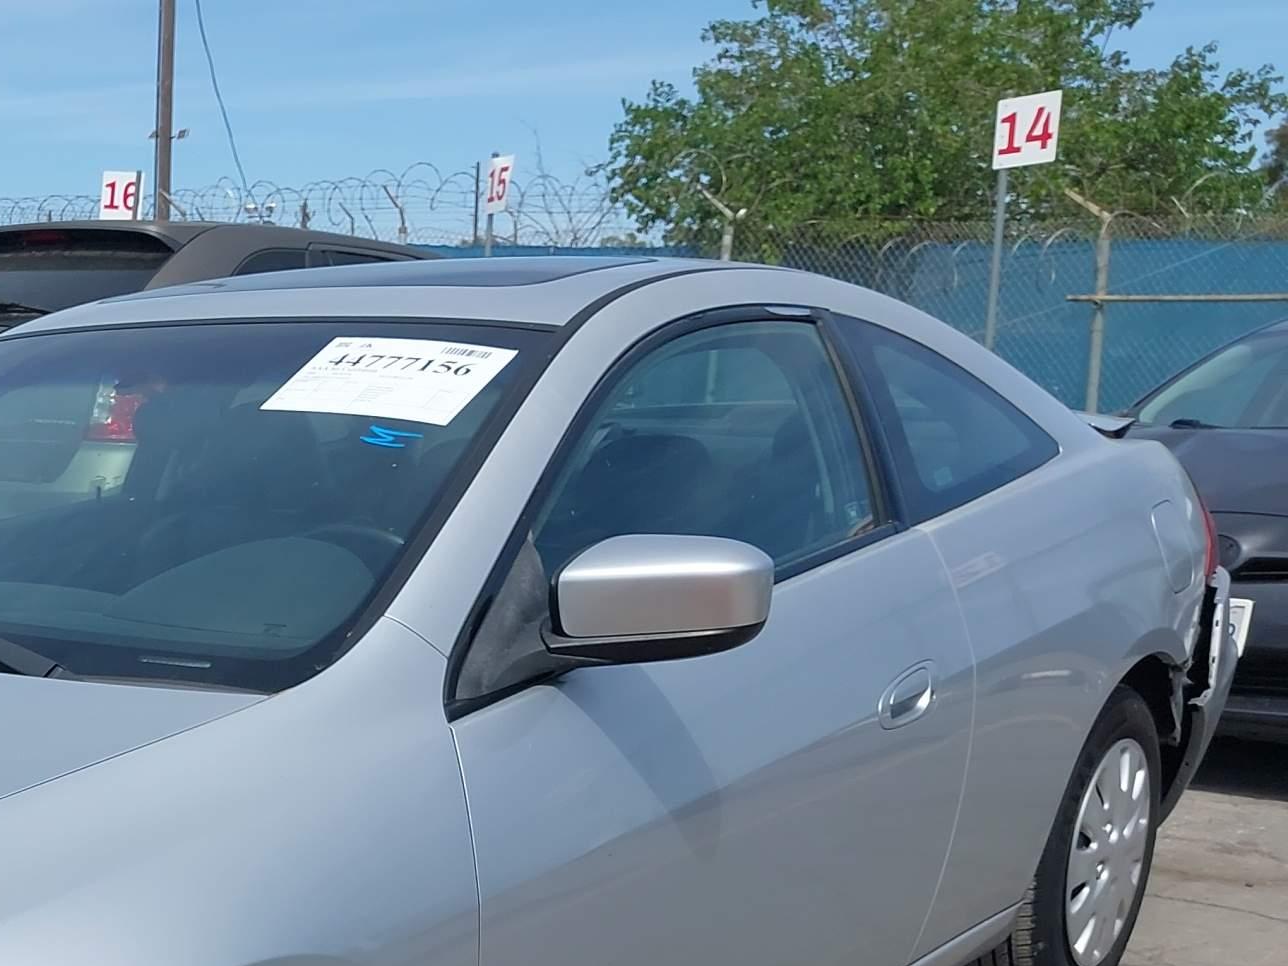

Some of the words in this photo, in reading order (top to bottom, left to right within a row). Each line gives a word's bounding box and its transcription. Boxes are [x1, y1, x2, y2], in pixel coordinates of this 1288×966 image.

[997, 106, 1055, 156] 14
[103, 181, 137, 211] 16
[487, 166, 510, 204] 15
[328, 352, 479, 377] 44777156
